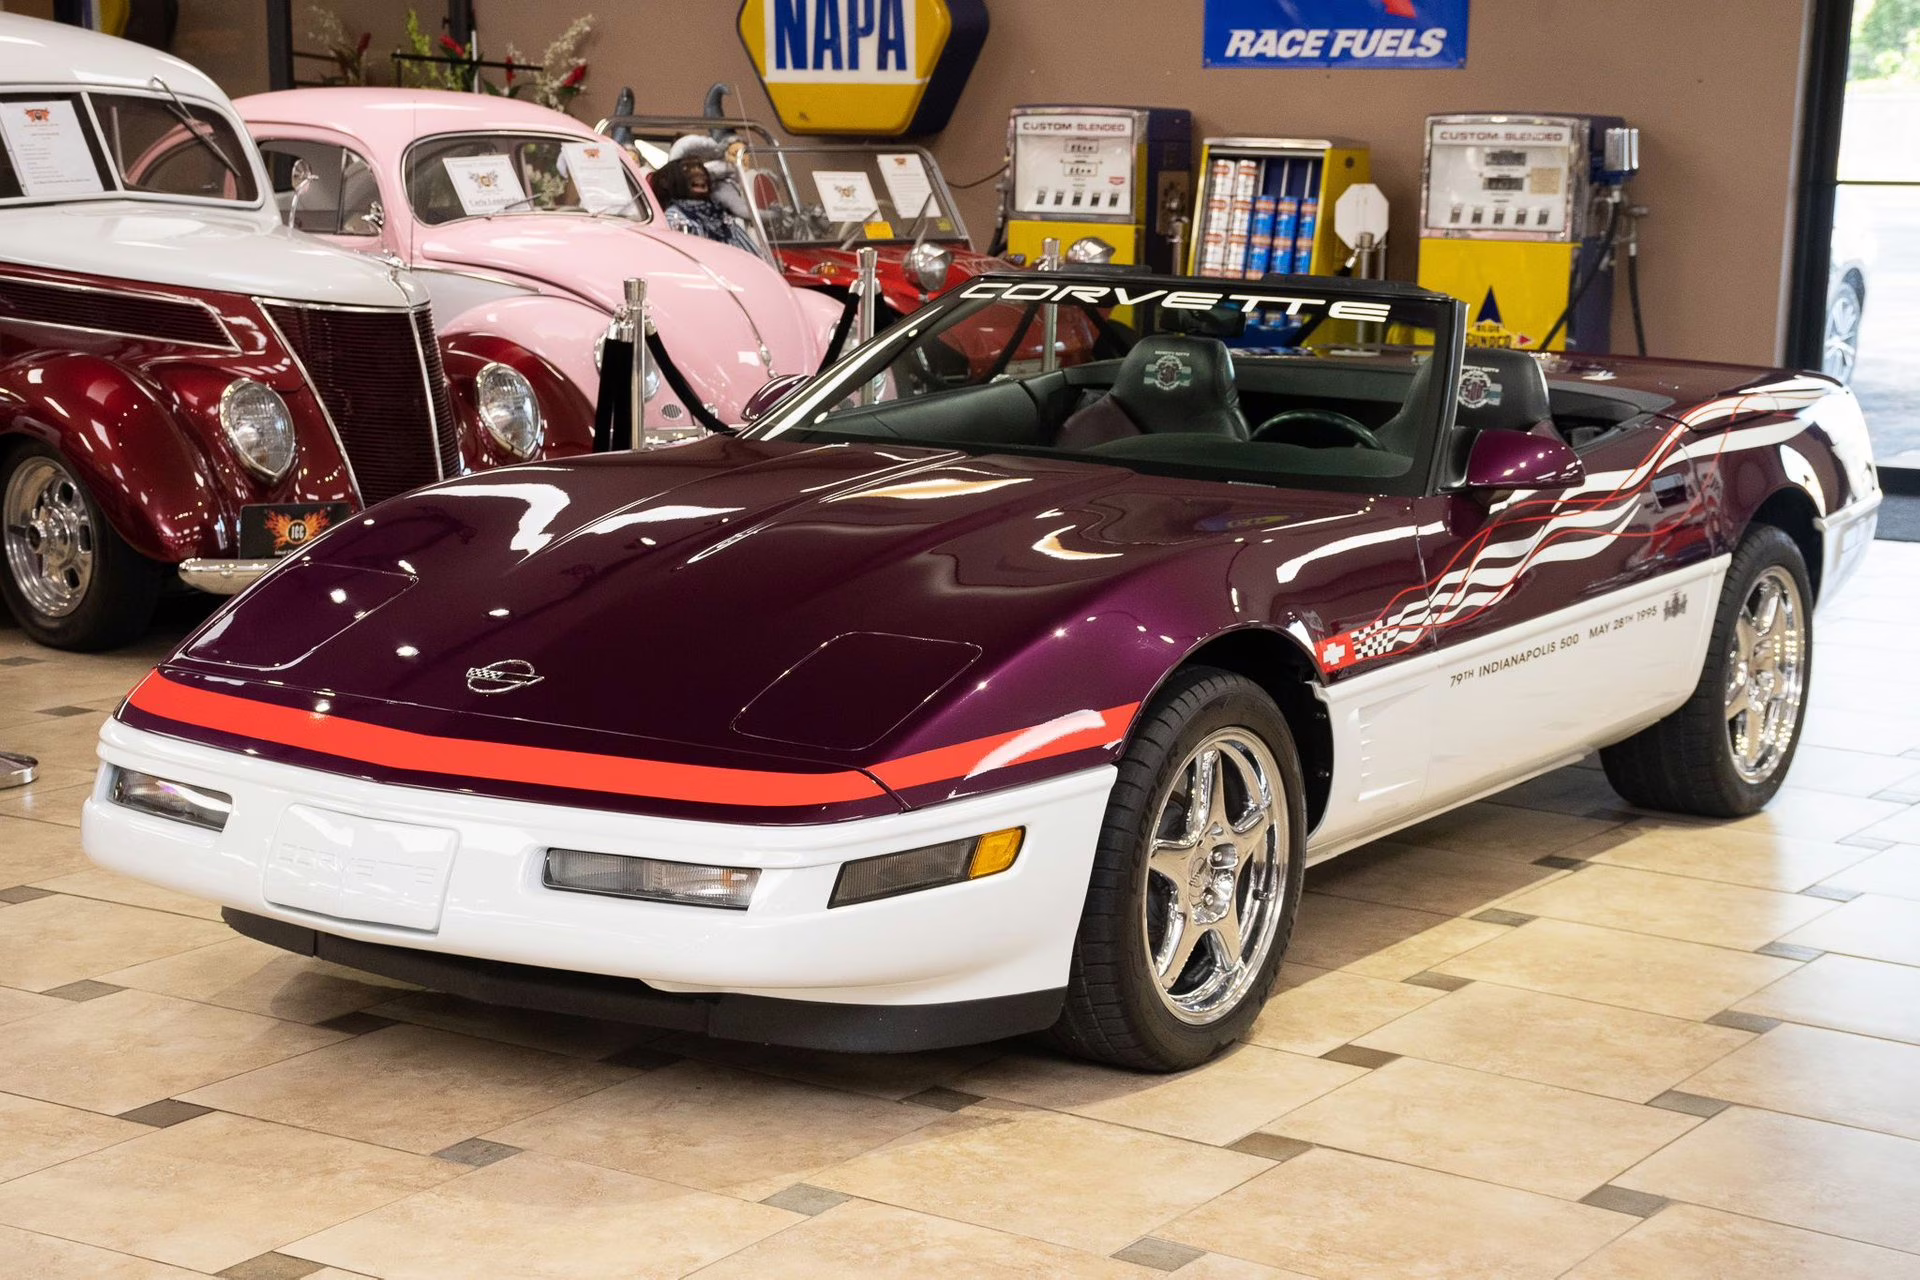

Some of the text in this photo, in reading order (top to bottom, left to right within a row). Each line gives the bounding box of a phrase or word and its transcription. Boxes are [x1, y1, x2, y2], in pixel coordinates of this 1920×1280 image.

[774, 0, 908, 70] NAPA
[1224, 28, 1448, 59] RACE FUELS
[1022, 122, 1126, 132] CUSTOM BLENDED
[1439, 131, 1563, 142] CUSTOM BLENDED
[959, 283, 1392, 323] CORVETTE
[1450, 605, 1657, 688] 79TH INDIANAPOLIS 500 MAY 28TH 1995
